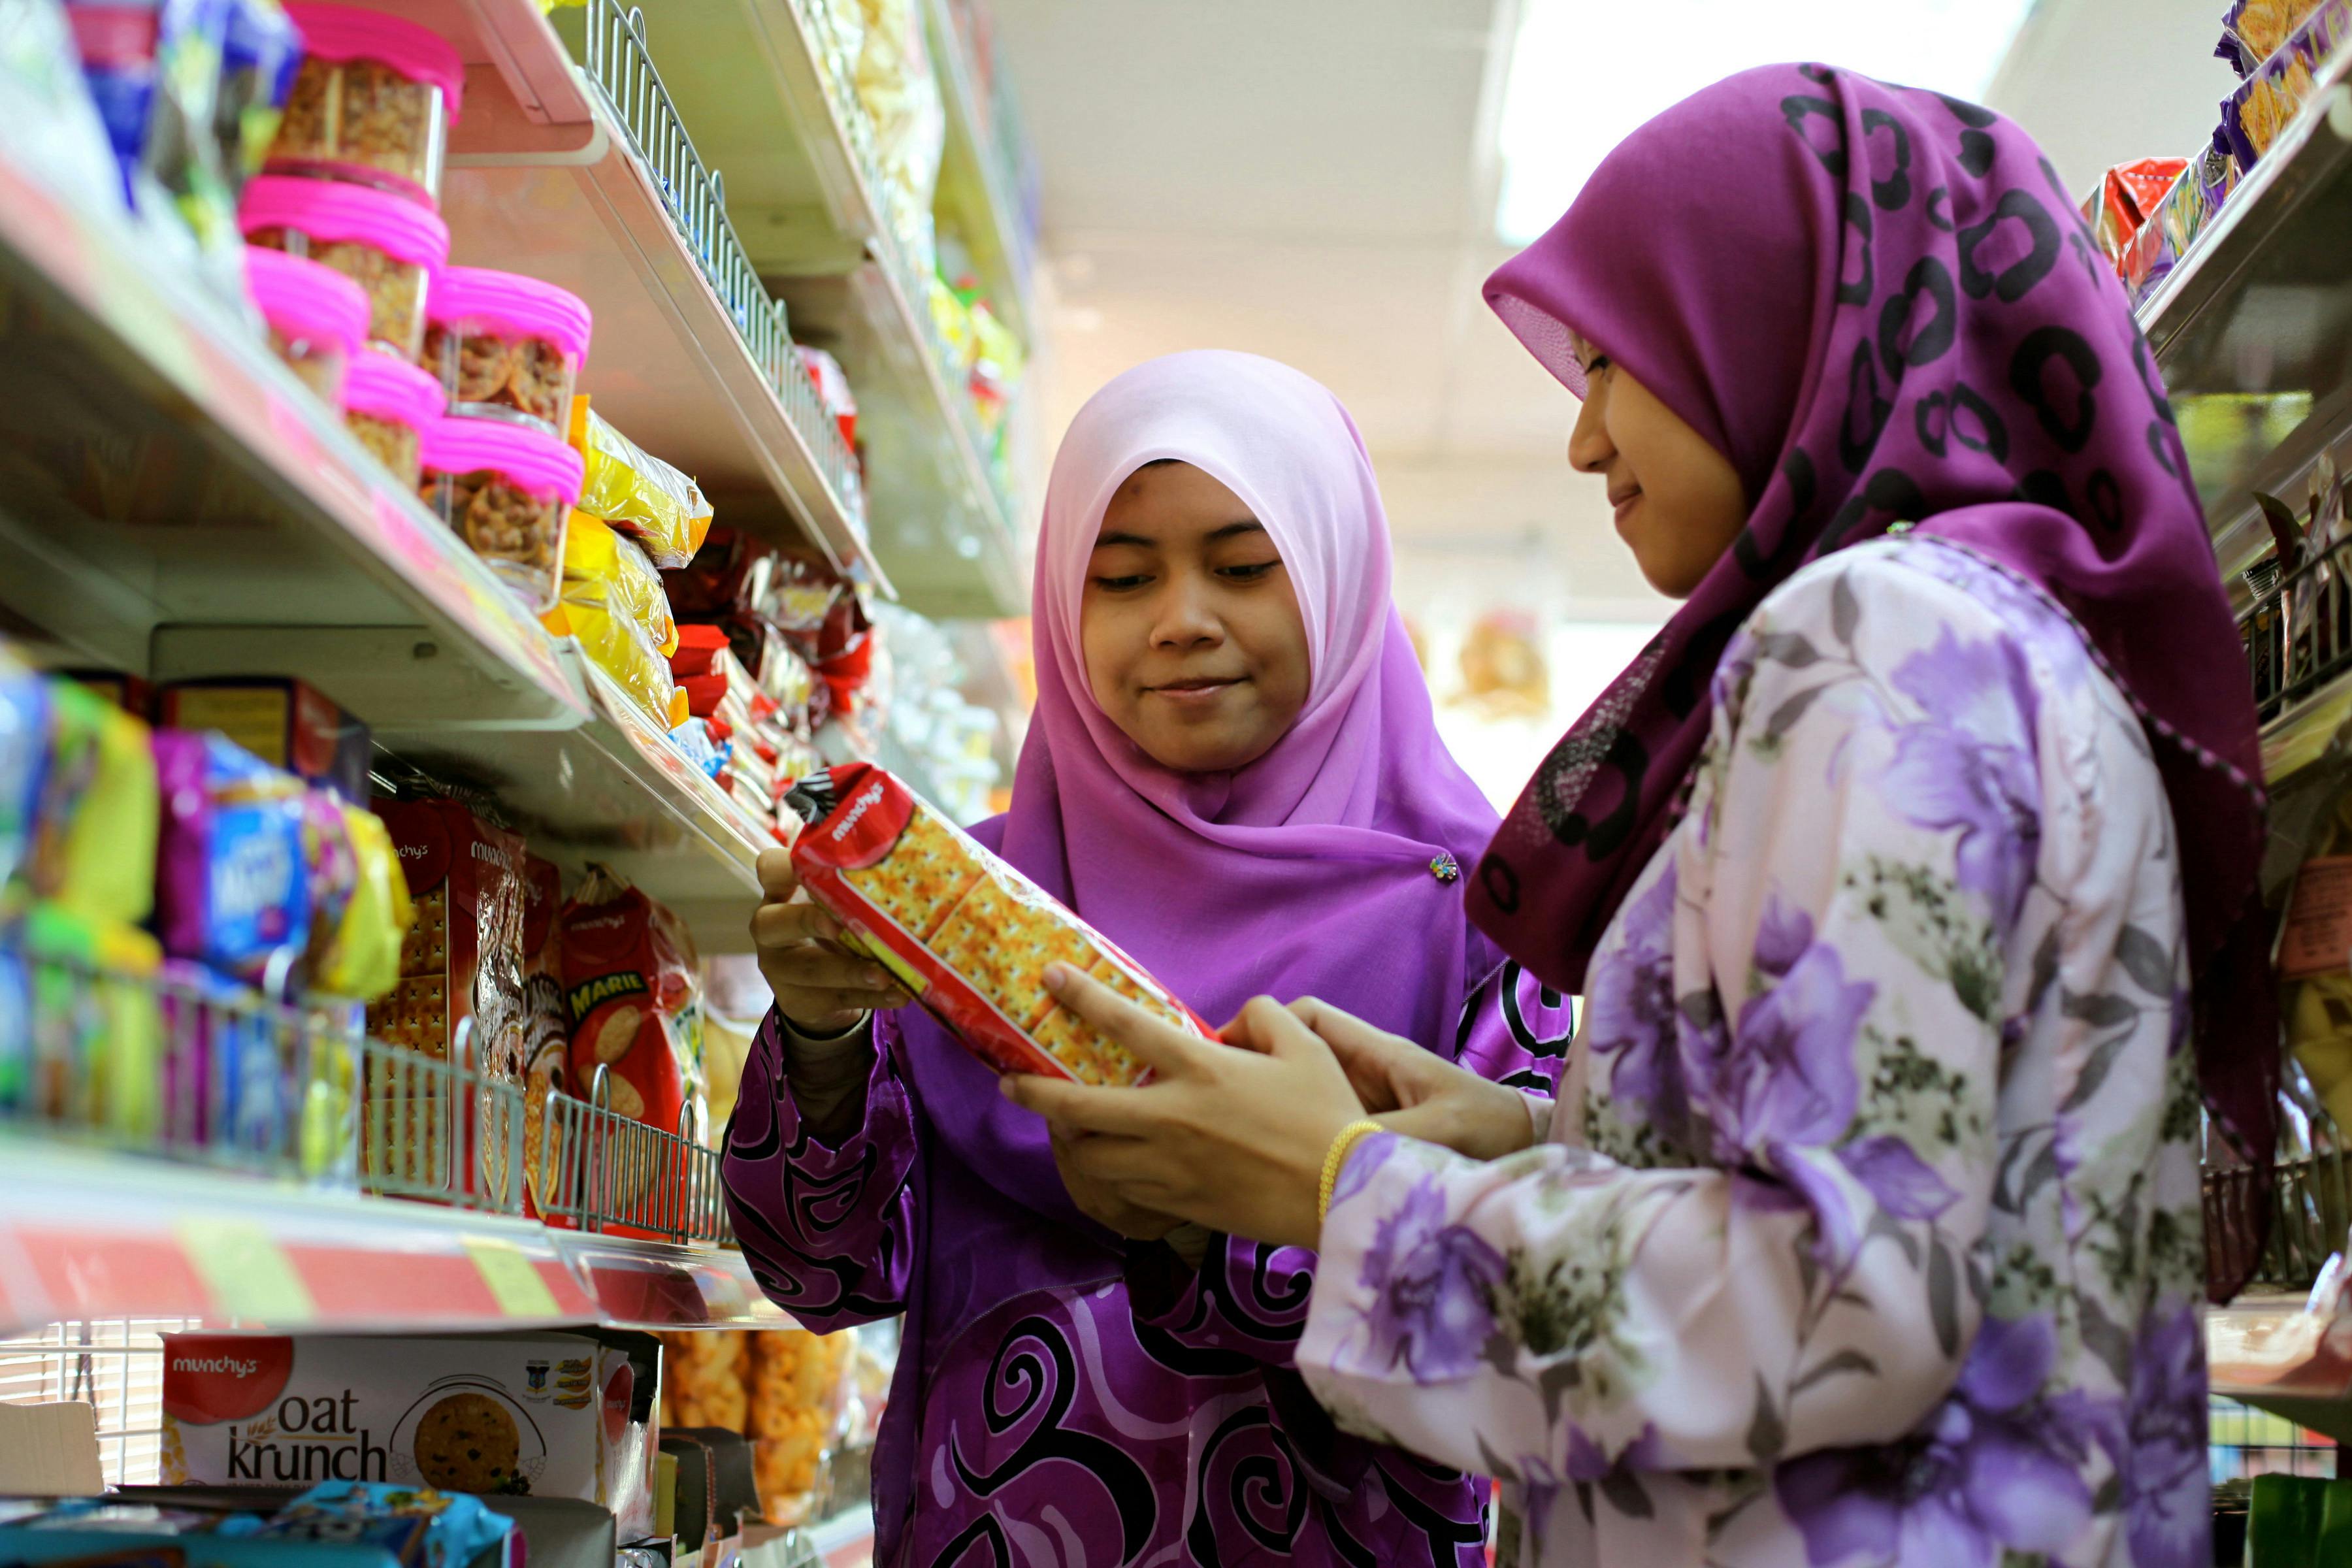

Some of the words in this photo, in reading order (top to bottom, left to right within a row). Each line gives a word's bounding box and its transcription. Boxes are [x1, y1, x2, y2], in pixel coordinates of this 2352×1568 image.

[832, 780, 884, 842] munchy's
[393, 844, 429, 860] nchy's
[570, 973, 644, 1021] MARIE
[173, 1356, 257, 1378] munchy's
[278, 1389, 359, 1433] oat
[227, 1426, 387, 1482] krunch
